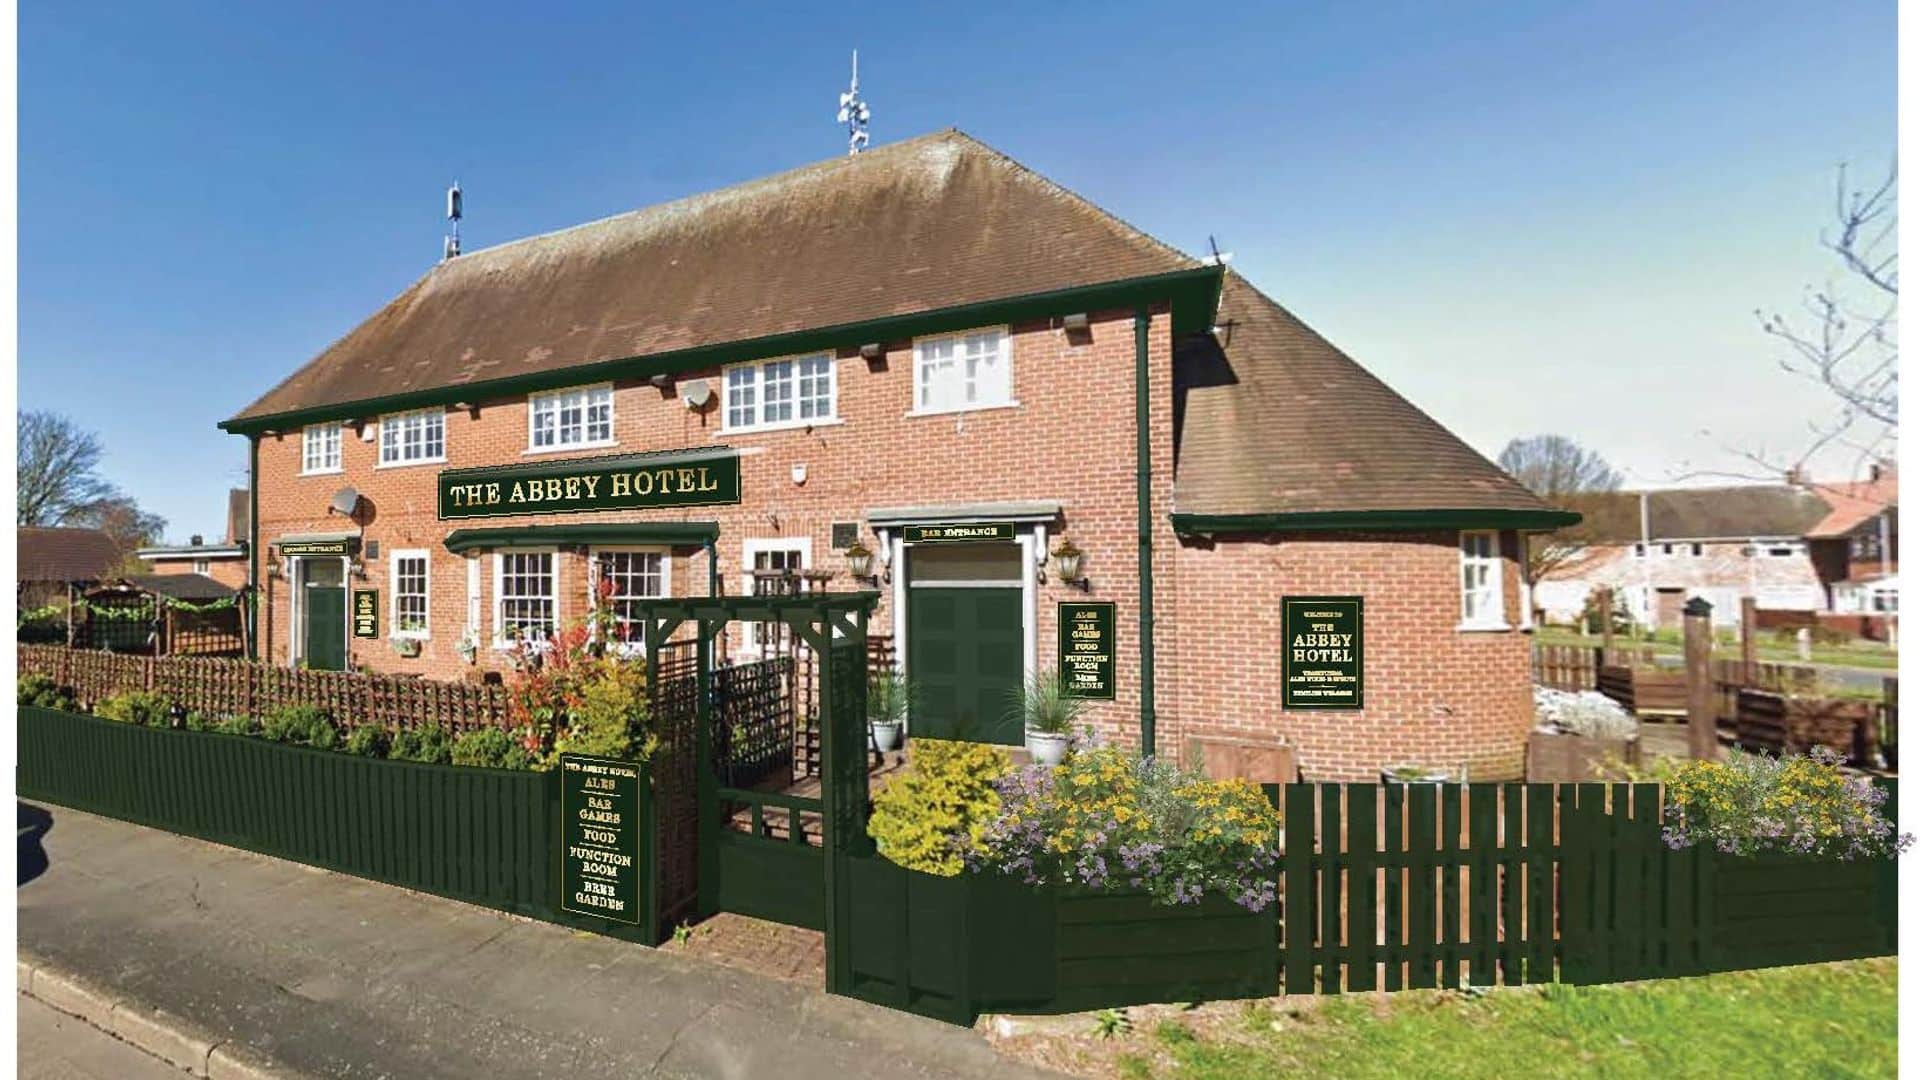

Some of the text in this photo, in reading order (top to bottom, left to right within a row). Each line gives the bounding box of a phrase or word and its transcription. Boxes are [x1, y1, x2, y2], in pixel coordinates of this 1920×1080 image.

[450, 468, 718, 507] THE ABBEY HOTEL
[943, 528, 998, 537] ENTRANCE
[1311, 623, 1335, 632] THE
[1074, 643, 1099, 651] FOOD
[1293, 633, 1353, 647] ABBEY
[1293, 649, 1353, 662] HOTEL
[582, 764, 609, 775] ABBEY
[584, 776, 616, 791] ALES
[588, 797, 613, 810] BAR
[579, 808, 621, 825] GAMES
[583, 828, 617, 844] FOOD
[569, 846, 633, 868] FUNCTION
[582, 861, 618, 877] ROOM
[575, 892, 625, 911] GARDEN
